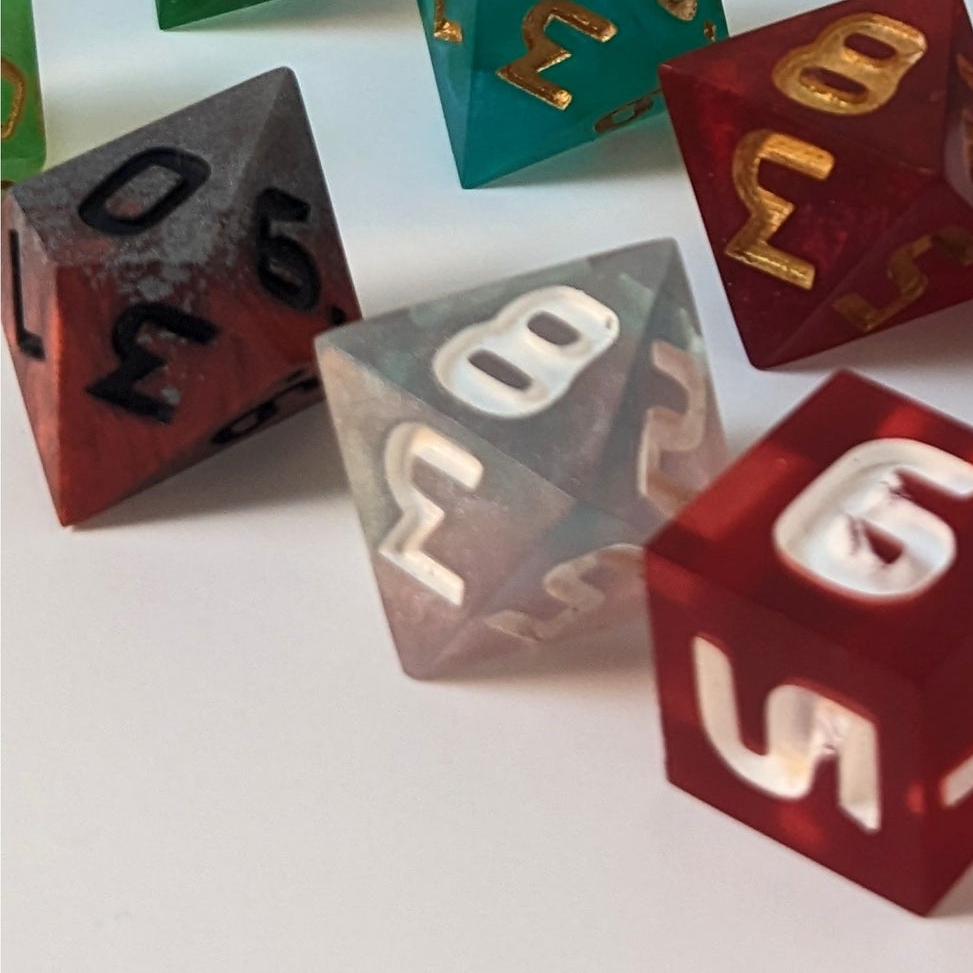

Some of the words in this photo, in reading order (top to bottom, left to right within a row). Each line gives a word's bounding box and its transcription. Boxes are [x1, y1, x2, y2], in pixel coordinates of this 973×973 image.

[771, 12, 928, 117] 8
[77, 146, 213, 236] 0
[724, 128, 836, 291] 3
[85, 301, 221, 426] 3
[432, 285, 620, 420] 8
[378, 421, 486, 607] 3
